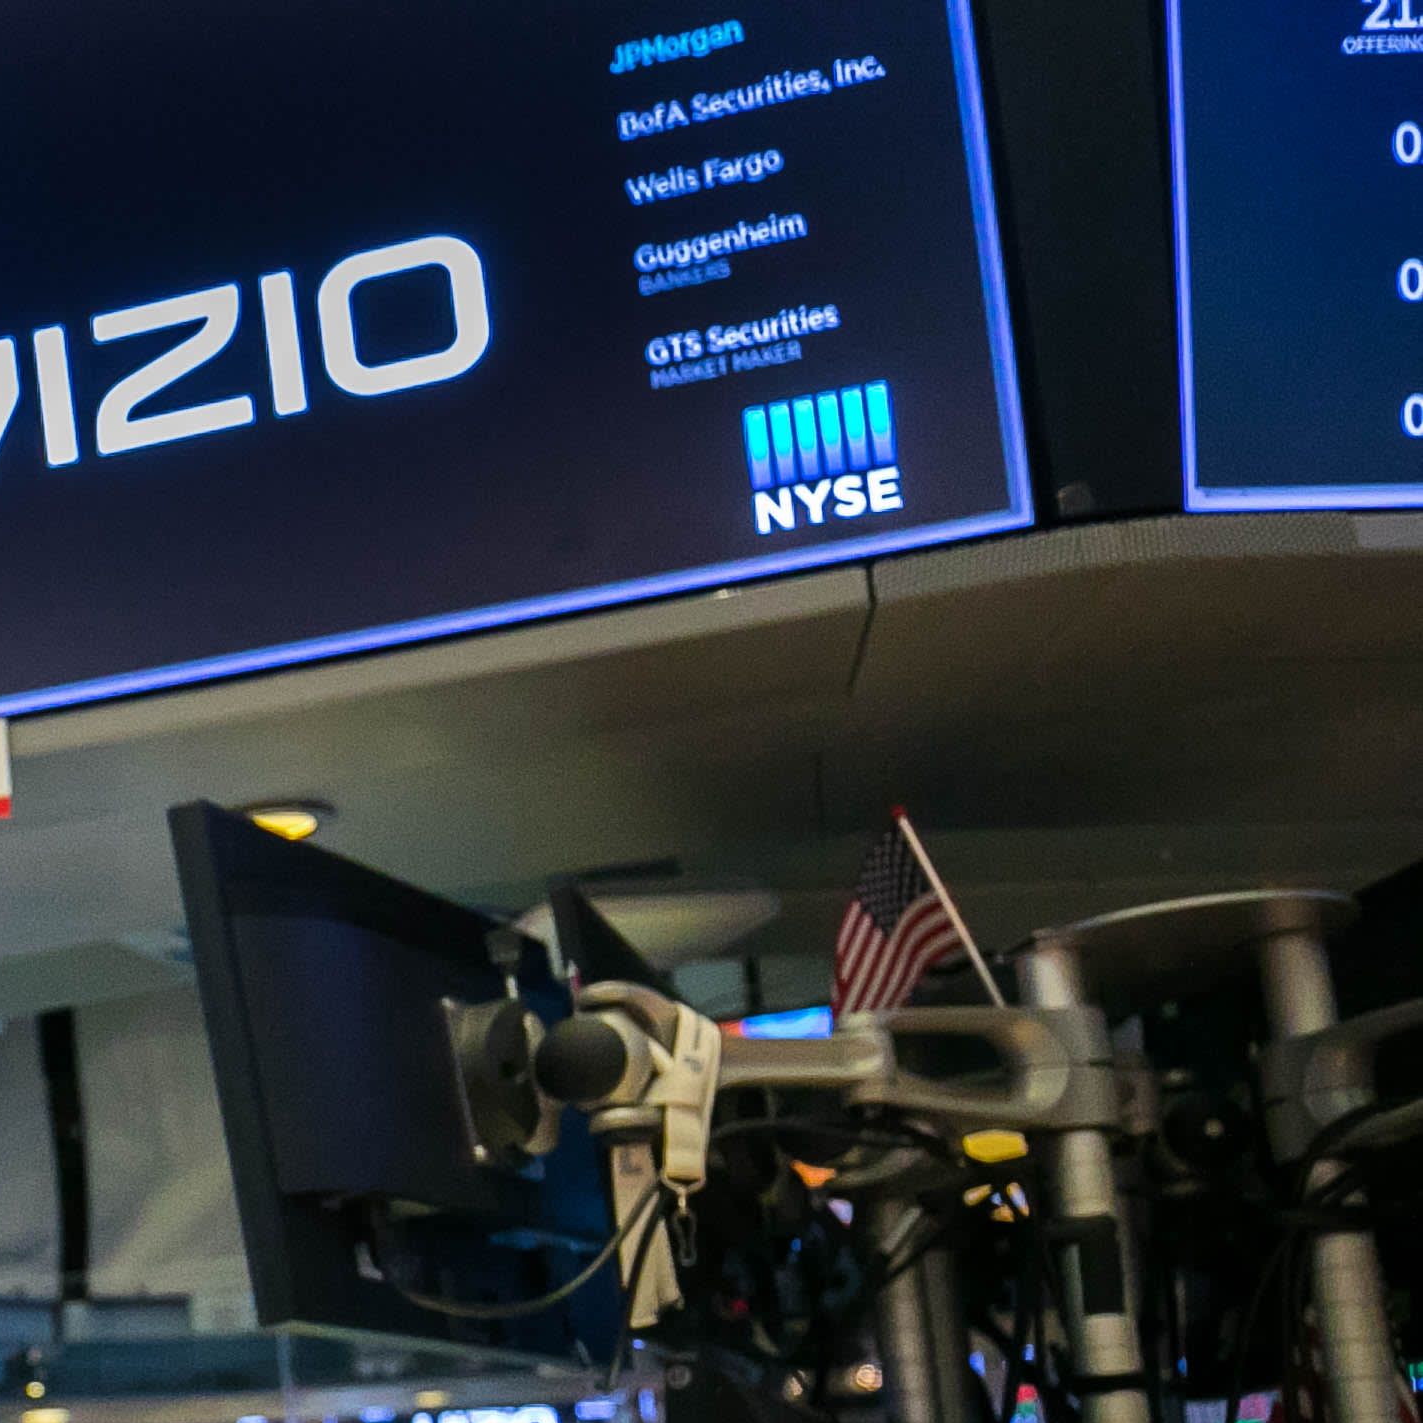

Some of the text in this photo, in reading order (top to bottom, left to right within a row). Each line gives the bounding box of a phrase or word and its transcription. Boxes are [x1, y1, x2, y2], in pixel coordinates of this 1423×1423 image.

[610, 19, 745, 74] JPMorgan
[617, 55, 886, 141] BofA Securities, Inc.
[624, 149, 785, 206] Wells Fargo
[634, 212, 808, 272] Guggenheim
[645, 304, 841, 366] GTS Securities
[650, 339, 802, 390] MARKET MAKER
[753, 465, 903, 534] NYSE
